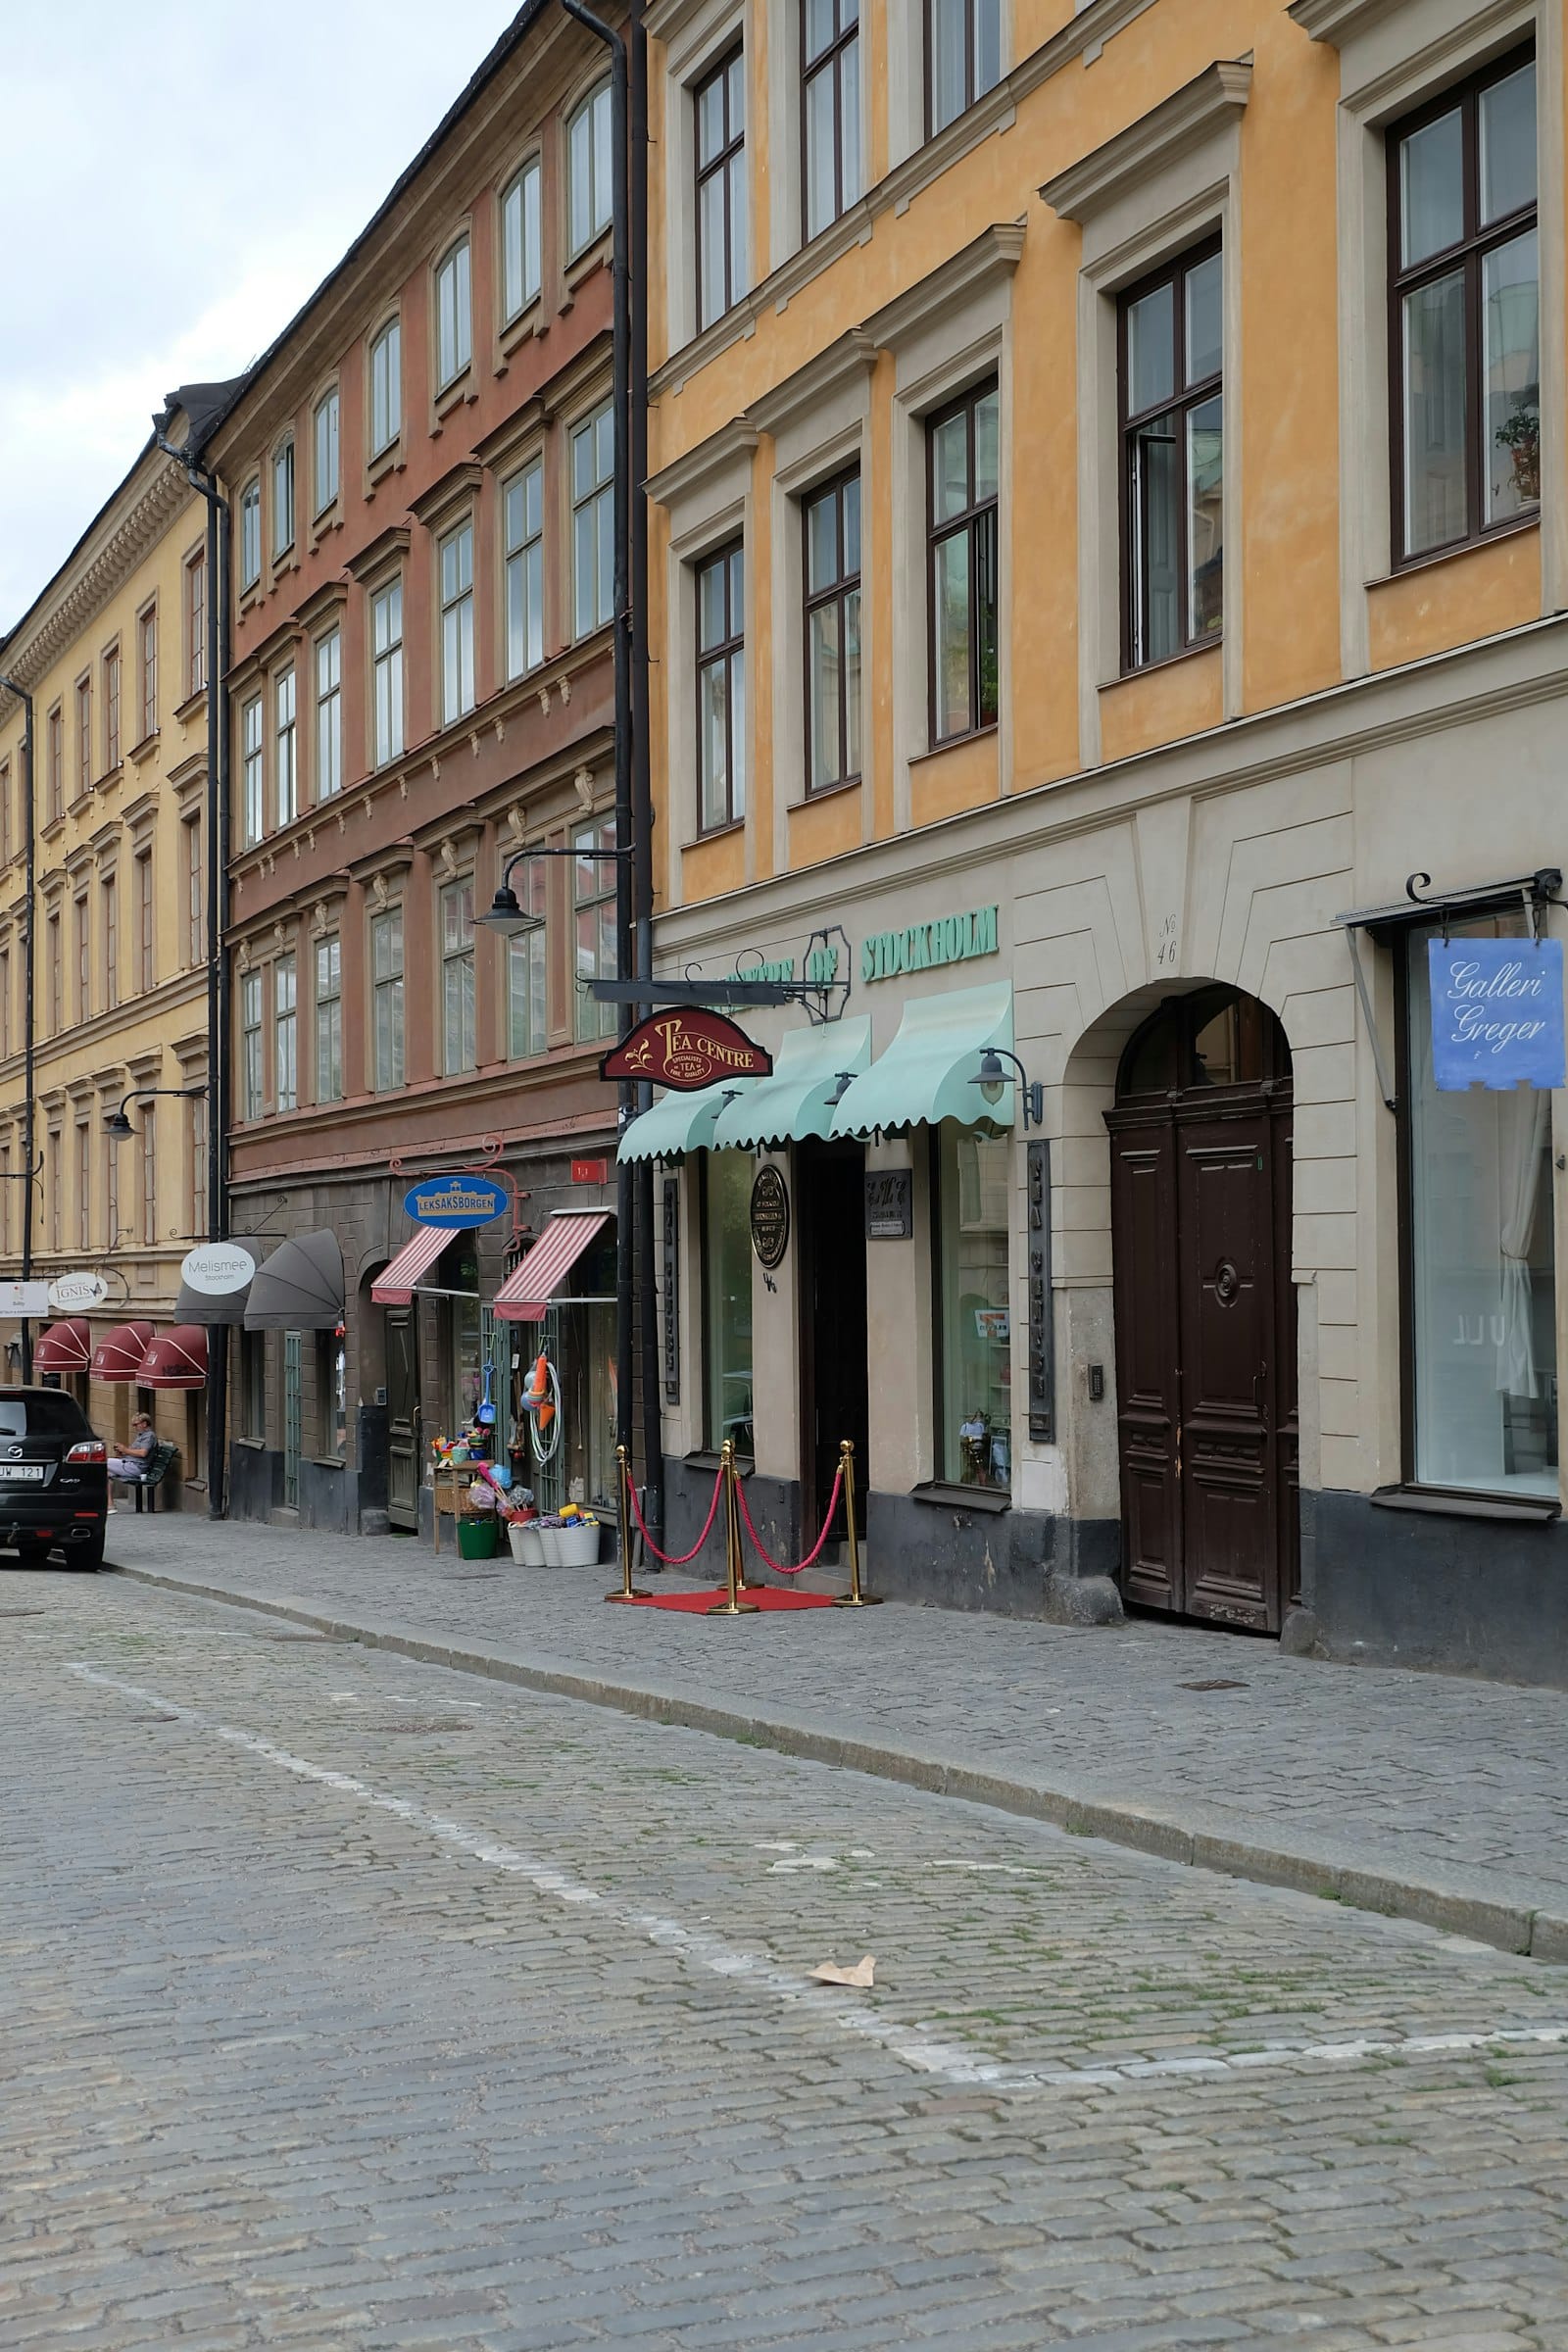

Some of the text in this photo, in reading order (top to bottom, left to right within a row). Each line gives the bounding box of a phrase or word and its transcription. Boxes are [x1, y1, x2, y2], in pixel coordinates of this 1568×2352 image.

[861, 905, 1000, 983] STOCKHOLM
[1156, 940, 1177, 964] 46
[1446, 960, 1545, 1000] Galleri
[1451, 1004, 1545, 1054] Greger
[654, 1019, 754, 1068] TEA CENTRE
[680, 1062, 696, 1071] TEA
[418, 1196, 494, 1211] LEKSAKSBORGEN
[188, 1259, 248, 1273] Melismee
[56, 1285, 90, 1299] IGNIS
[22, 1466, 40, 1477] 121
